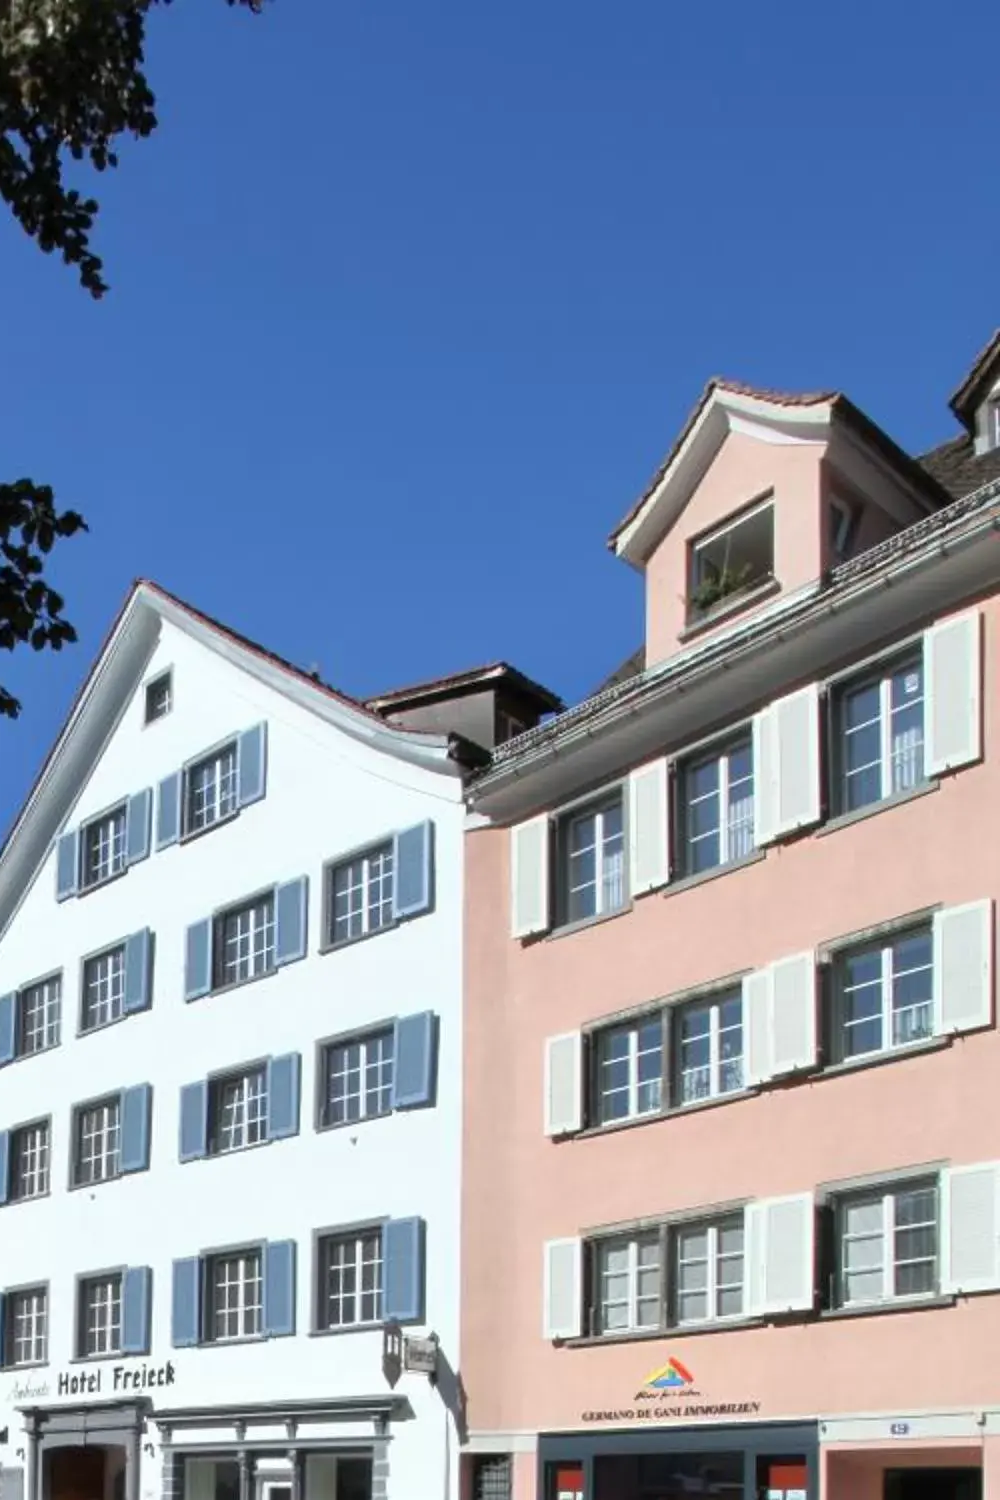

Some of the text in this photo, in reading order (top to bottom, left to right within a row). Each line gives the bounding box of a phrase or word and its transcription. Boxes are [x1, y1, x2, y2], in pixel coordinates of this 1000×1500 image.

[58, 1369, 101, 1396] Hotel
[582, 1409, 634, 1422] GERMANO
[637, 1408, 651, 1419] DE
[684, 1401, 761, 1417] IMMOBILIEN
